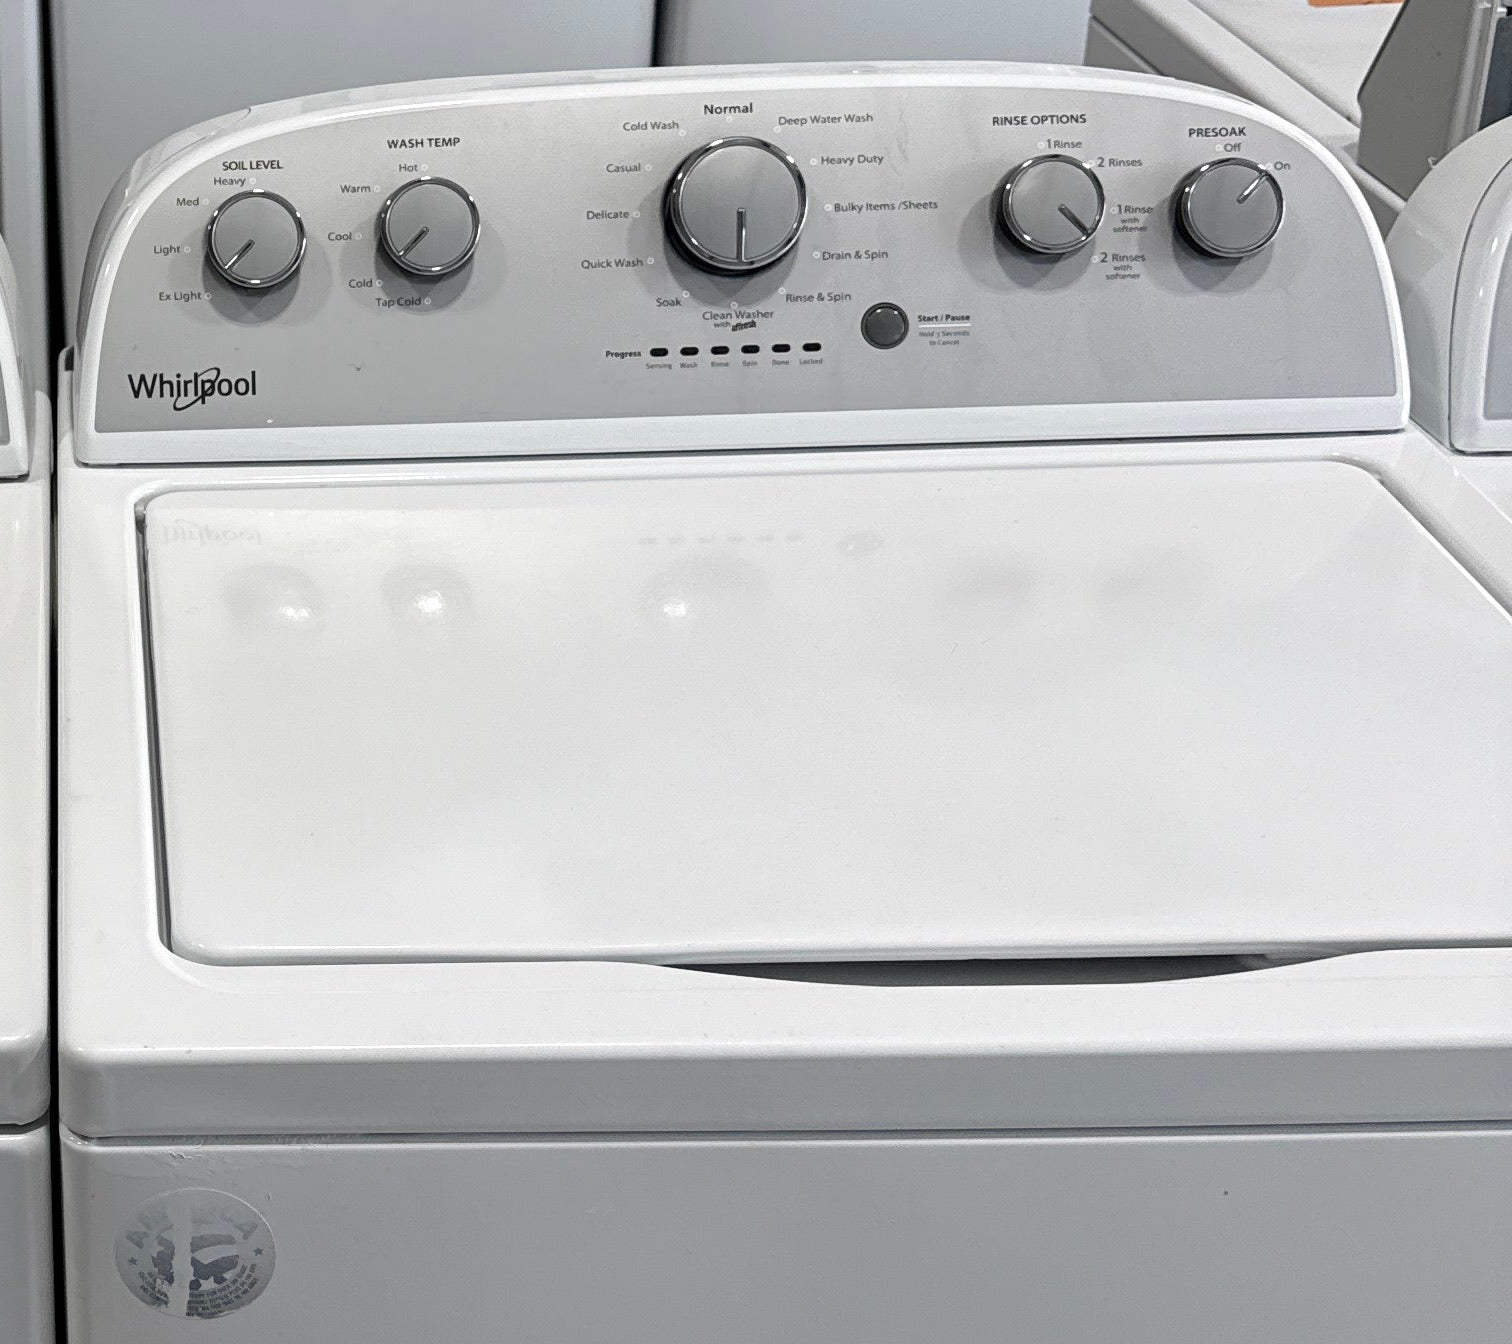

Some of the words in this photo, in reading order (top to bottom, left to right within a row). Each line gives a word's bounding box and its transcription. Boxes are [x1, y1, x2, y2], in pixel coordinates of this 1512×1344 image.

[704, 103, 753, 115] Normal
[778, 116, 807, 128] Deep
[810, 115, 842, 125] Water
[844, 113, 874, 123] Wash
[993, 116, 1028, 126] RINSE
[1031, 114, 1087, 125] OPTIONS
[623, 121, 648, 132] Cold
[651, 121, 679, 131] Wash
[1188, 127, 1246, 138] PRESOAK
[387, 139, 425, 150] WASH
[427, 137, 461, 148] TEMP
[1047, 139, 1051, 149] 1
[1054, 139, 1082, 149] Rinse
[1224, 143, 1241, 152] Off
[222, 161, 247, 171] SOIL
[249, 160, 283, 170] LEVEL
[821, 155, 852, 167] Heavy
[856, 154, 884, 166] Duty
[1097, 157, 1104, 168] 2
[1109, 158, 1142, 167] Rinses
[1274, 161, 1291, 170] On
[399, 163, 418, 173] Hot
[606, 163, 641, 174] Casual
[214, 176, 246, 188] Heavy
[340, 184, 371, 193] Warm
[176, 197, 199, 207] Med
[834, 202, 863, 215] Bulky
[865, 201, 895, 212] Items
[1117, 205, 1123, 214] 1
[1125, 205, 1153, 214] Rinse
[587, 209, 630, 220] Delicate
[1113, 225, 1148, 233] softener
[328, 232, 352, 241] Cool
[154, 244, 181, 256] Light
[822, 250, 851, 261] Drain
[854, 250, 862, 260] &
[864, 249, 888, 263] Spin
[1100, 253, 1108, 263] 2
[1112, 253, 1145, 262] Rinses
[581, 259, 611, 271] Quick
[614, 258, 643, 269] Wash
[1105, 272, 1140, 281] softener
[349, 279, 373, 289] Cold
[159, 292, 171, 301] Ex
[174, 291, 202, 303] Light
[376, 298, 394, 309] Tap
[396, 296, 422, 307] Cold
[656, 297, 682, 308] Soak
[786, 293, 814, 303] Rinse
[816, 293, 824, 302] &
[826, 291, 852, 305] Spin
[702, 310, 731, 321] Clean
[734, 309, 774, 320] Washer
[605, 351, 641, 359] Progress
[128, 368, 257, 412] Whirlpool
